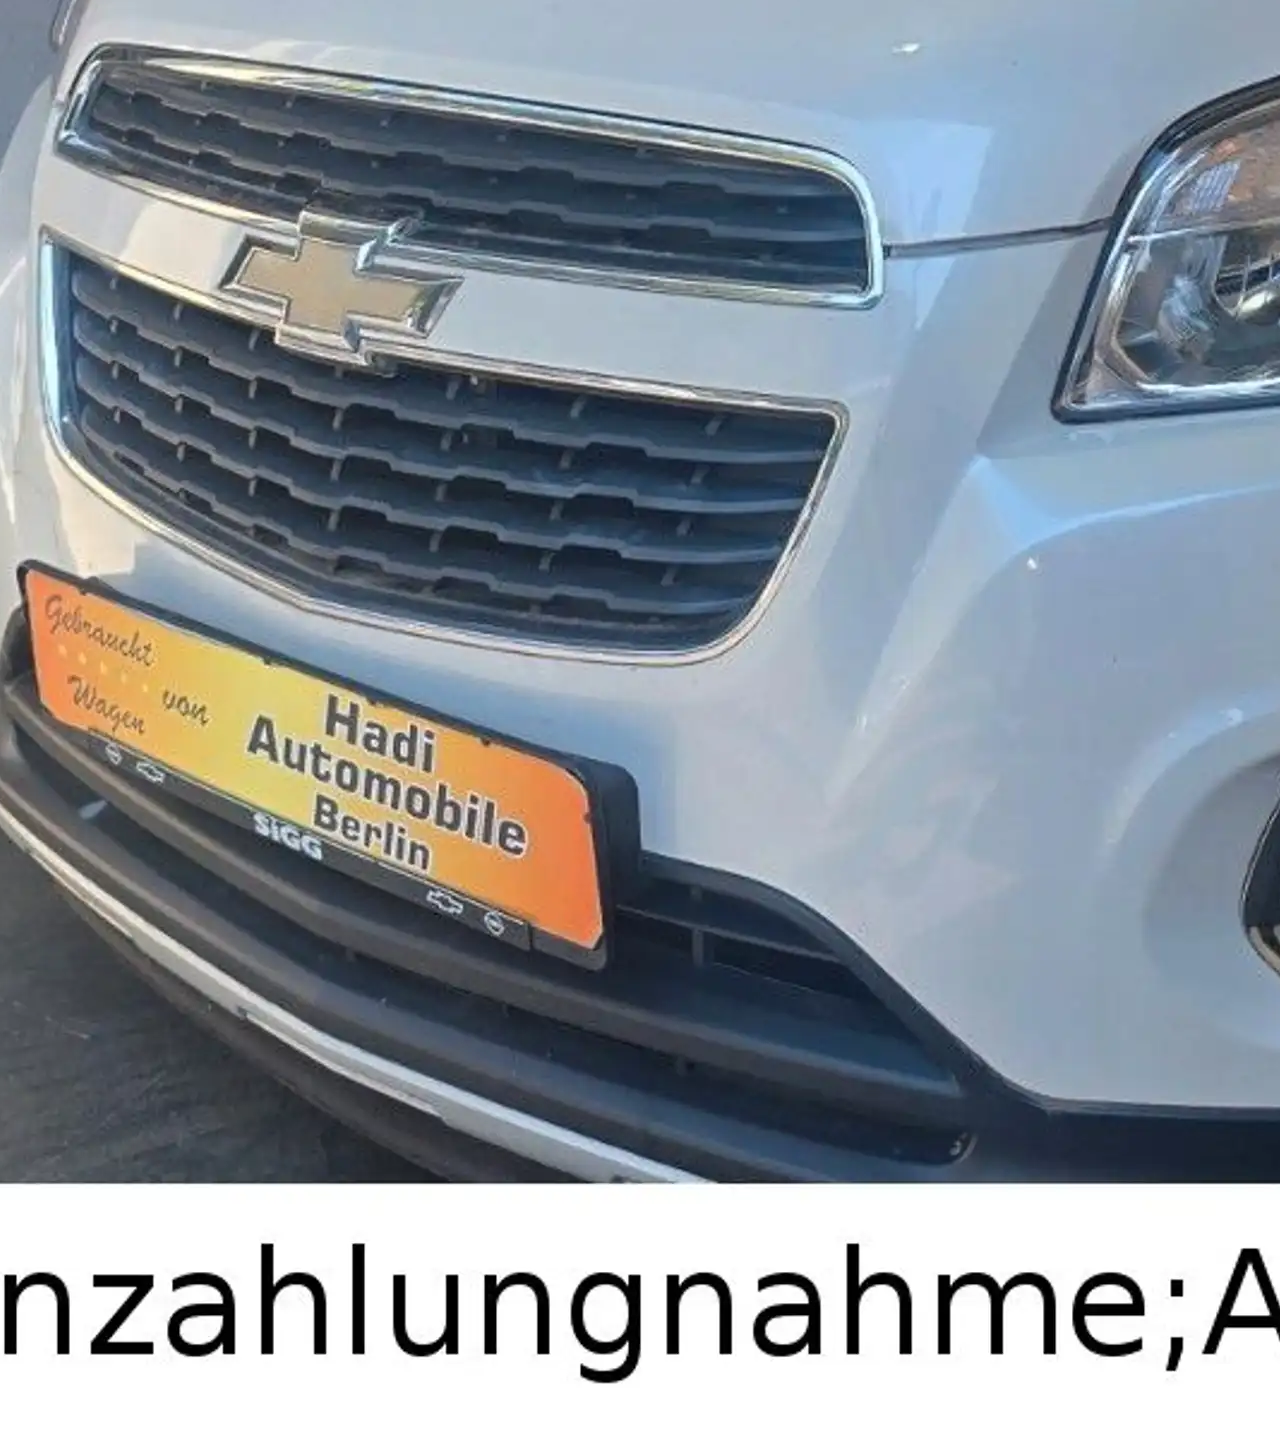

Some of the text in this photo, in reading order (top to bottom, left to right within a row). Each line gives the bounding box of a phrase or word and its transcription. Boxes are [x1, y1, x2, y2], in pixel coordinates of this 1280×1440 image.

[44, 594, 156, 668] Gebraucht
[67, 674, 146, 736] Wagen
[160, 687, 211, 727] von
[324, 693, 436, 774] Hadi
[246, 713, 528, 859] Automobile
[312, 792, 432, 872] Berlin
